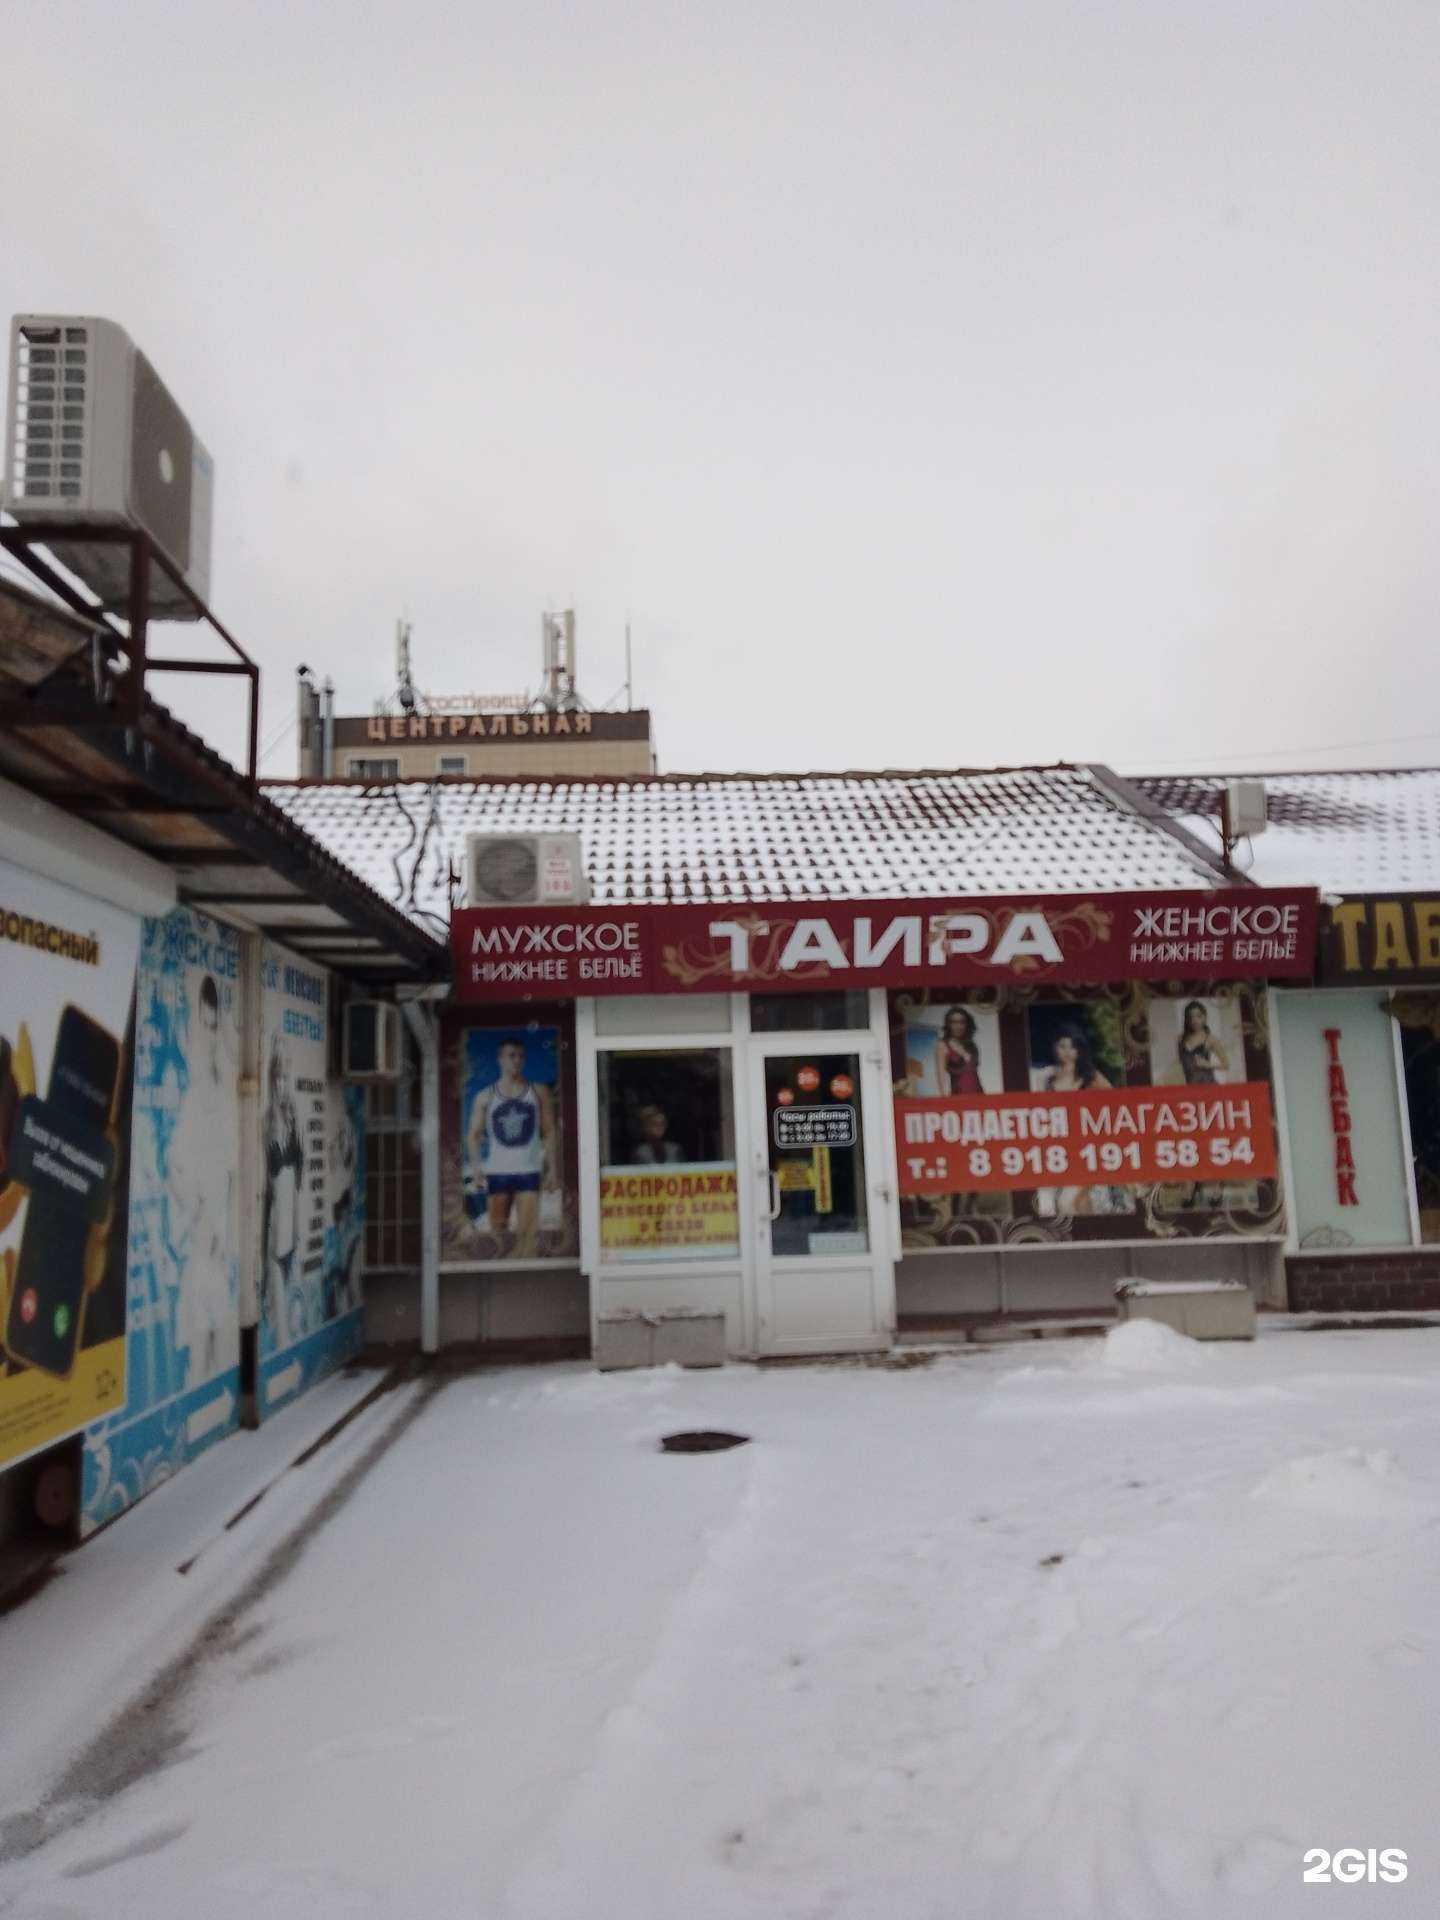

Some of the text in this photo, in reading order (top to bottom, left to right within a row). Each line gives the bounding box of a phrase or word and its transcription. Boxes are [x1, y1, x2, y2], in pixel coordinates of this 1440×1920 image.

[367, 714, 592, 741] ЦЕНТРАЛЬНАЯ
[1133, 905, 1298, 937] ЖЕНСКОЕ
[472, 922, 640, 954] МУЖСКОЕ
[709, 912, 1064, 972] ТАИРА
[1130, 940, 1224, 962] НИЖНЕЕ
[472, 958, 568, 983] НИЖНЕЕ
[904, 1100, 1251, 1146] ПРОДАЕТСЯ МАГАЗИН
[1322, 1028, 1359, 1206] ТАБАК
[969, 1148, 992, 1177] 8
[1001, 1146, 1068, 1176] 918
[1080, 1141, 1141, 1172] 191
[1155, 1138, 1199, 1168] 58
[1209, 1136, 1254, 1166] 54
